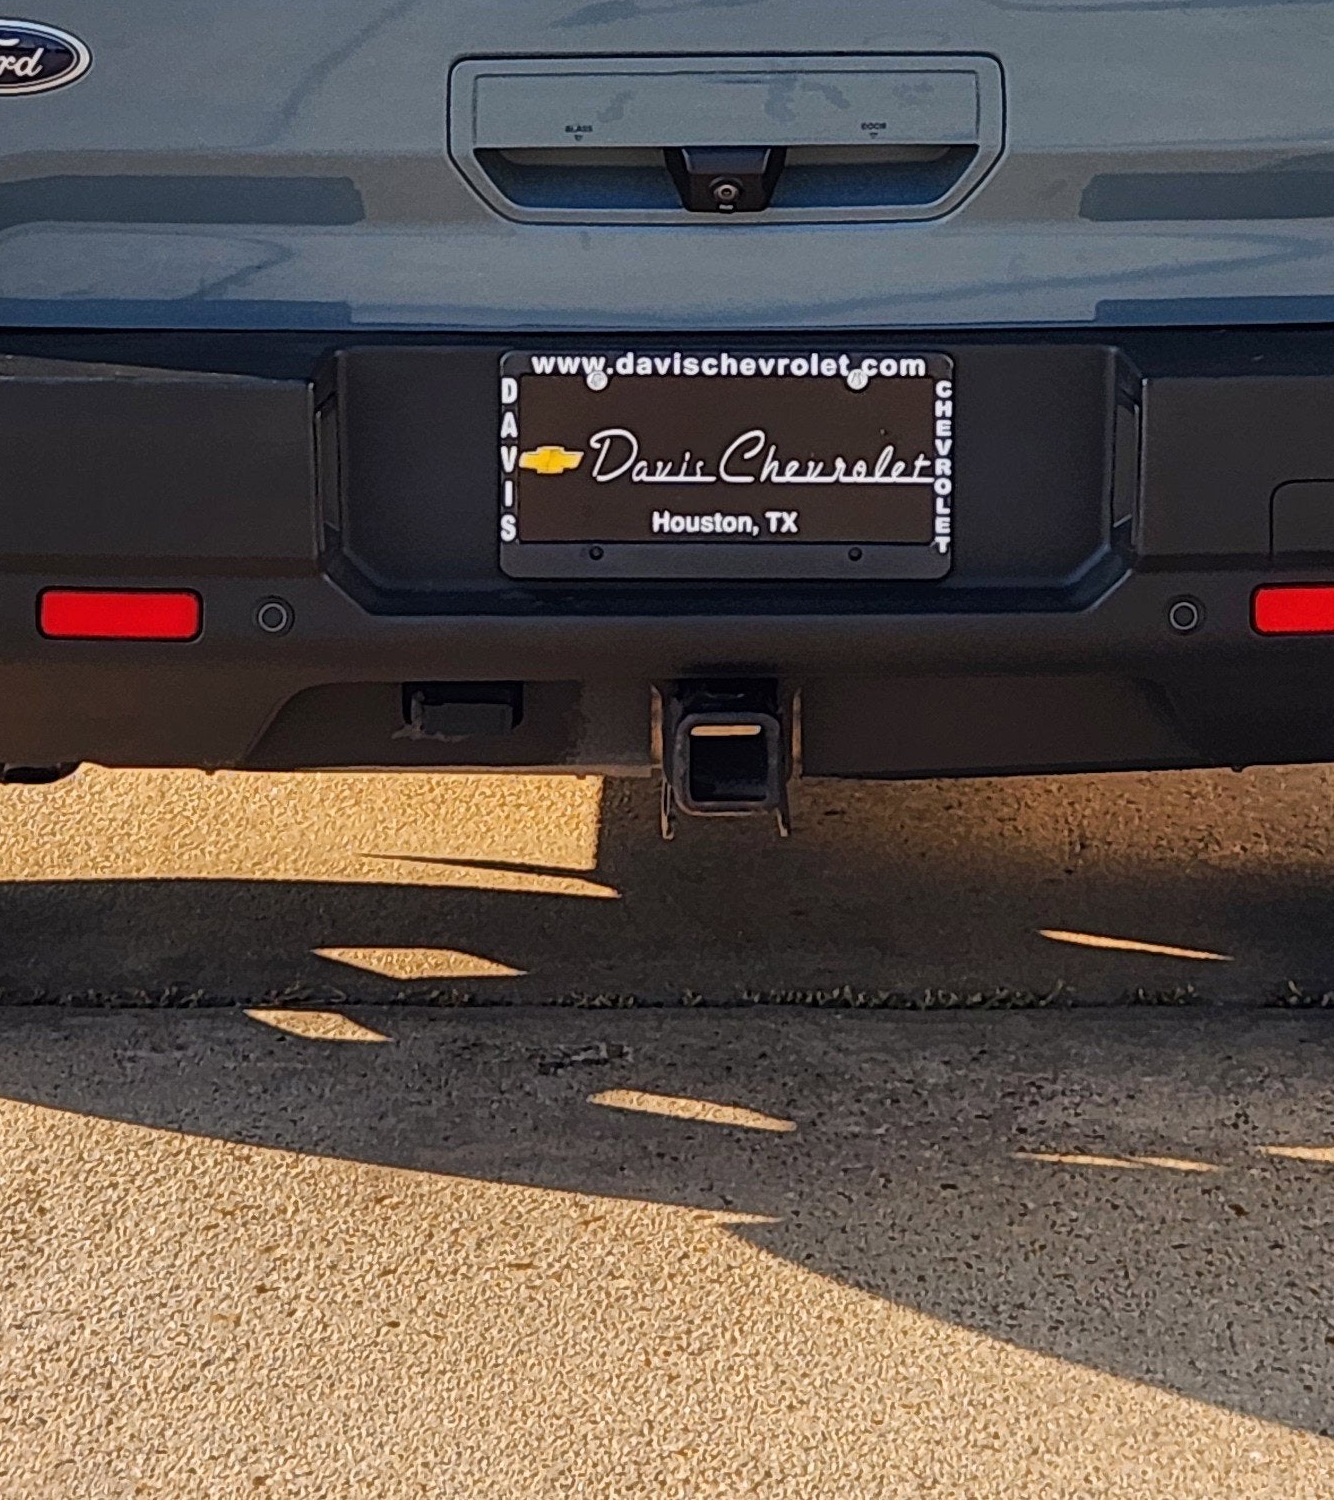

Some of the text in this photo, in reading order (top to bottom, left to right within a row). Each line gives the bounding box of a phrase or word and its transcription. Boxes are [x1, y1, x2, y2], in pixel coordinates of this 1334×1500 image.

[531, 352, 927, 377] www.davischevroletcom
[500, 377, 518, 542] DAVIS
[589, 428, 934, 484] Davis Chevrolet
[933, 379, 953, 554] CHEVROLET
[651, 511, 800, 537] Houston, TX
